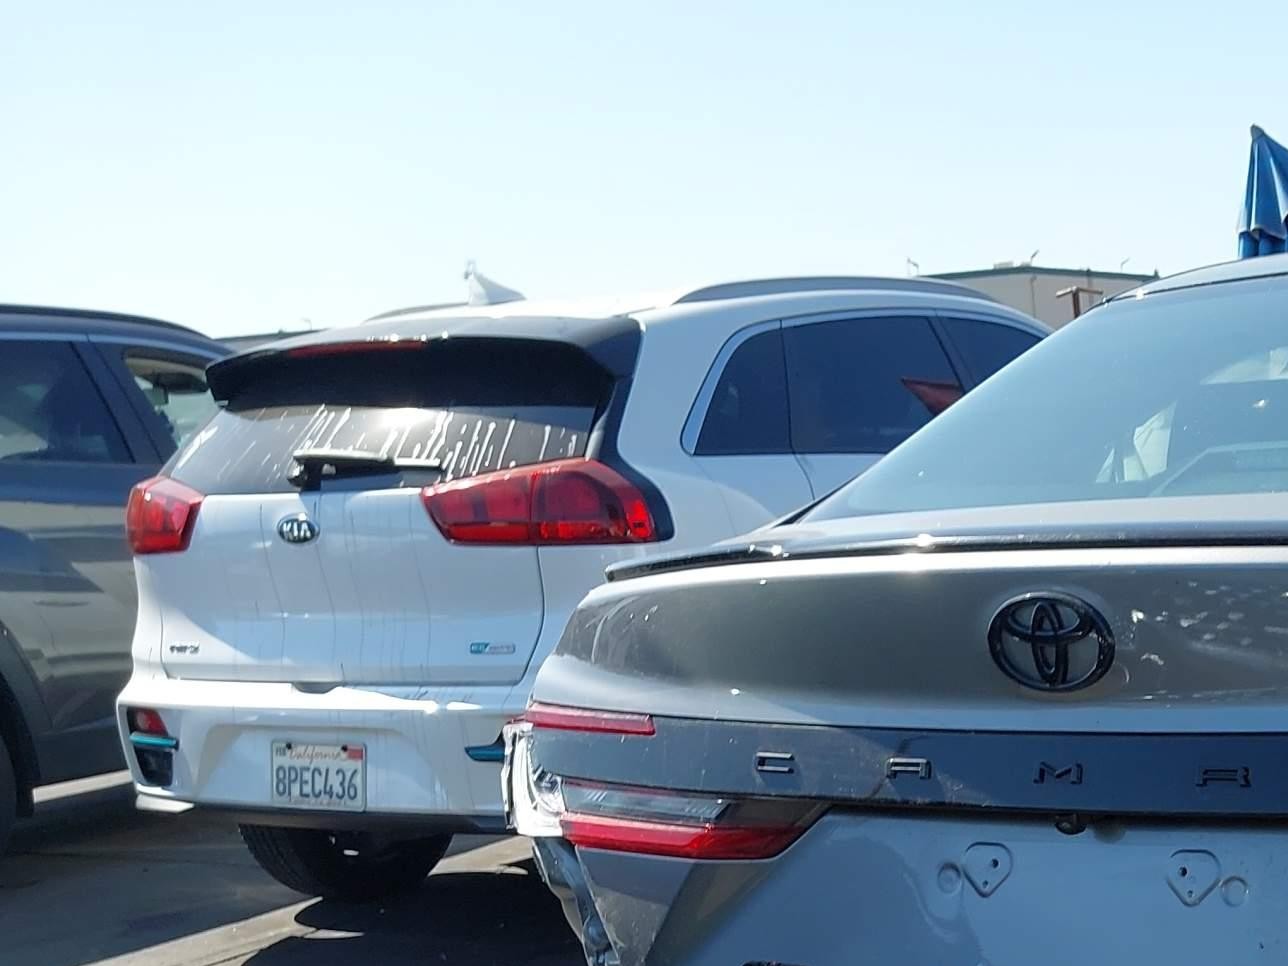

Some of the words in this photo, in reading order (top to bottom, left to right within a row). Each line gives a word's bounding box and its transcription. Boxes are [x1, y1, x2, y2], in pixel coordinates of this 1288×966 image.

[282, 521, 311, 540] KIA
[288, 744, 342, 765] California
[275, 765, 358, 801] 8PEC436
